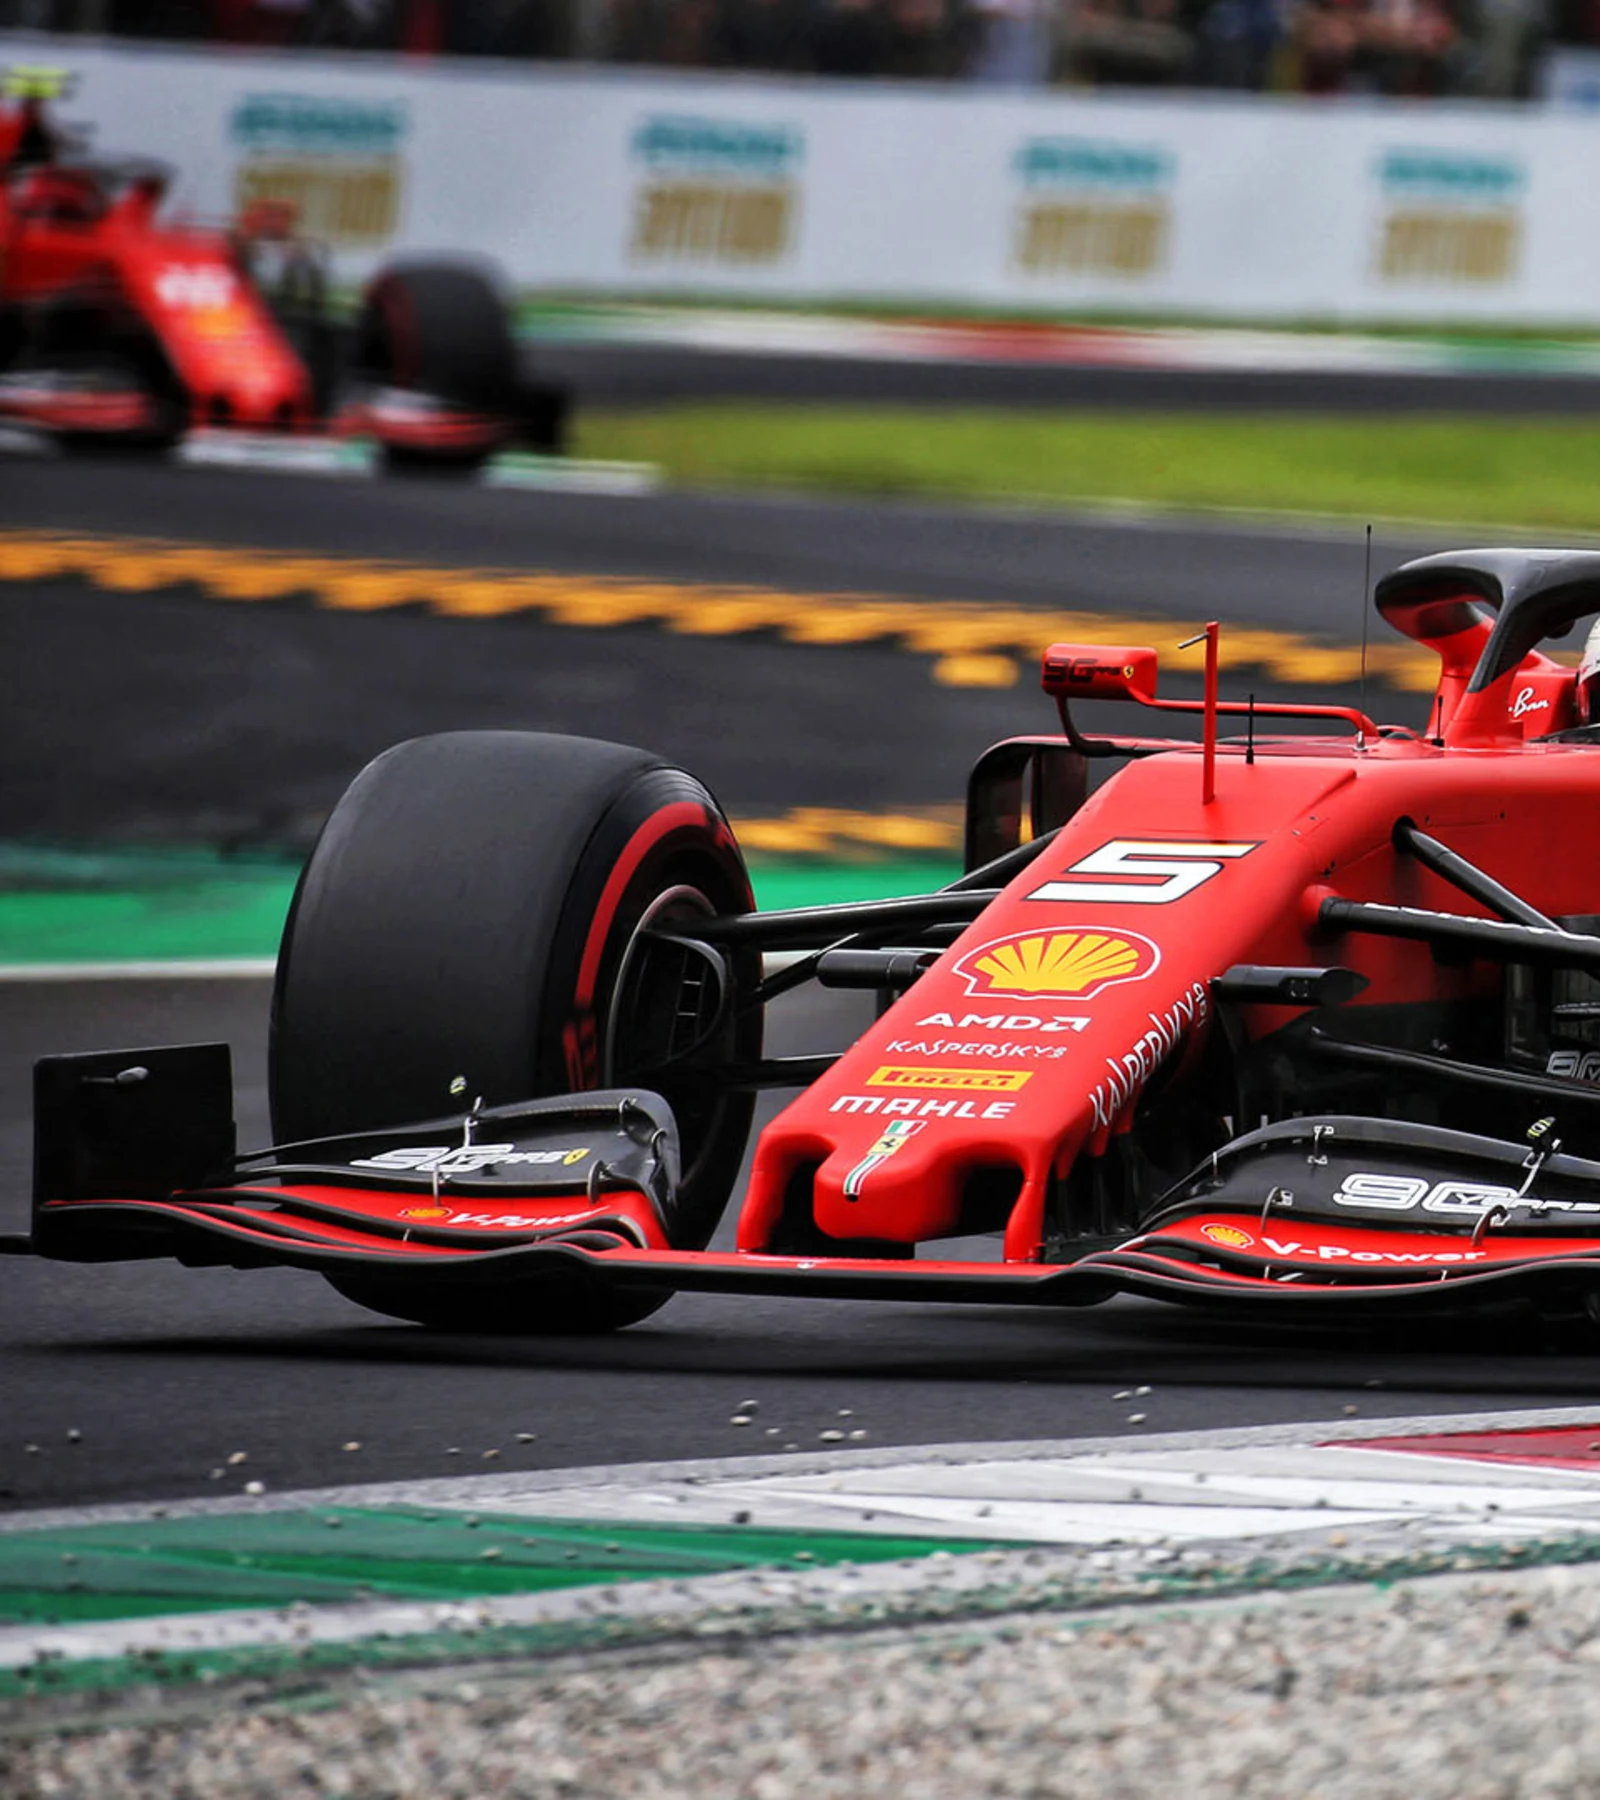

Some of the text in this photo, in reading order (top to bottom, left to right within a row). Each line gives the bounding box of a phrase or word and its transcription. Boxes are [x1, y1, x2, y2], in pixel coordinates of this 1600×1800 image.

[1022, 838, 1266, 904] 5
[915, 1012, 1042, 1031] AMD
[886, 1039, 1053, 1058] KASPERSKY
[883, 1070, 1015, 1087] PIRELLI
[829, 1095, 1016, 1119] MAHLE
[1333, 1173, 1520, 1214] 90
[1261, 1237, 1486, 1263] V-Power
